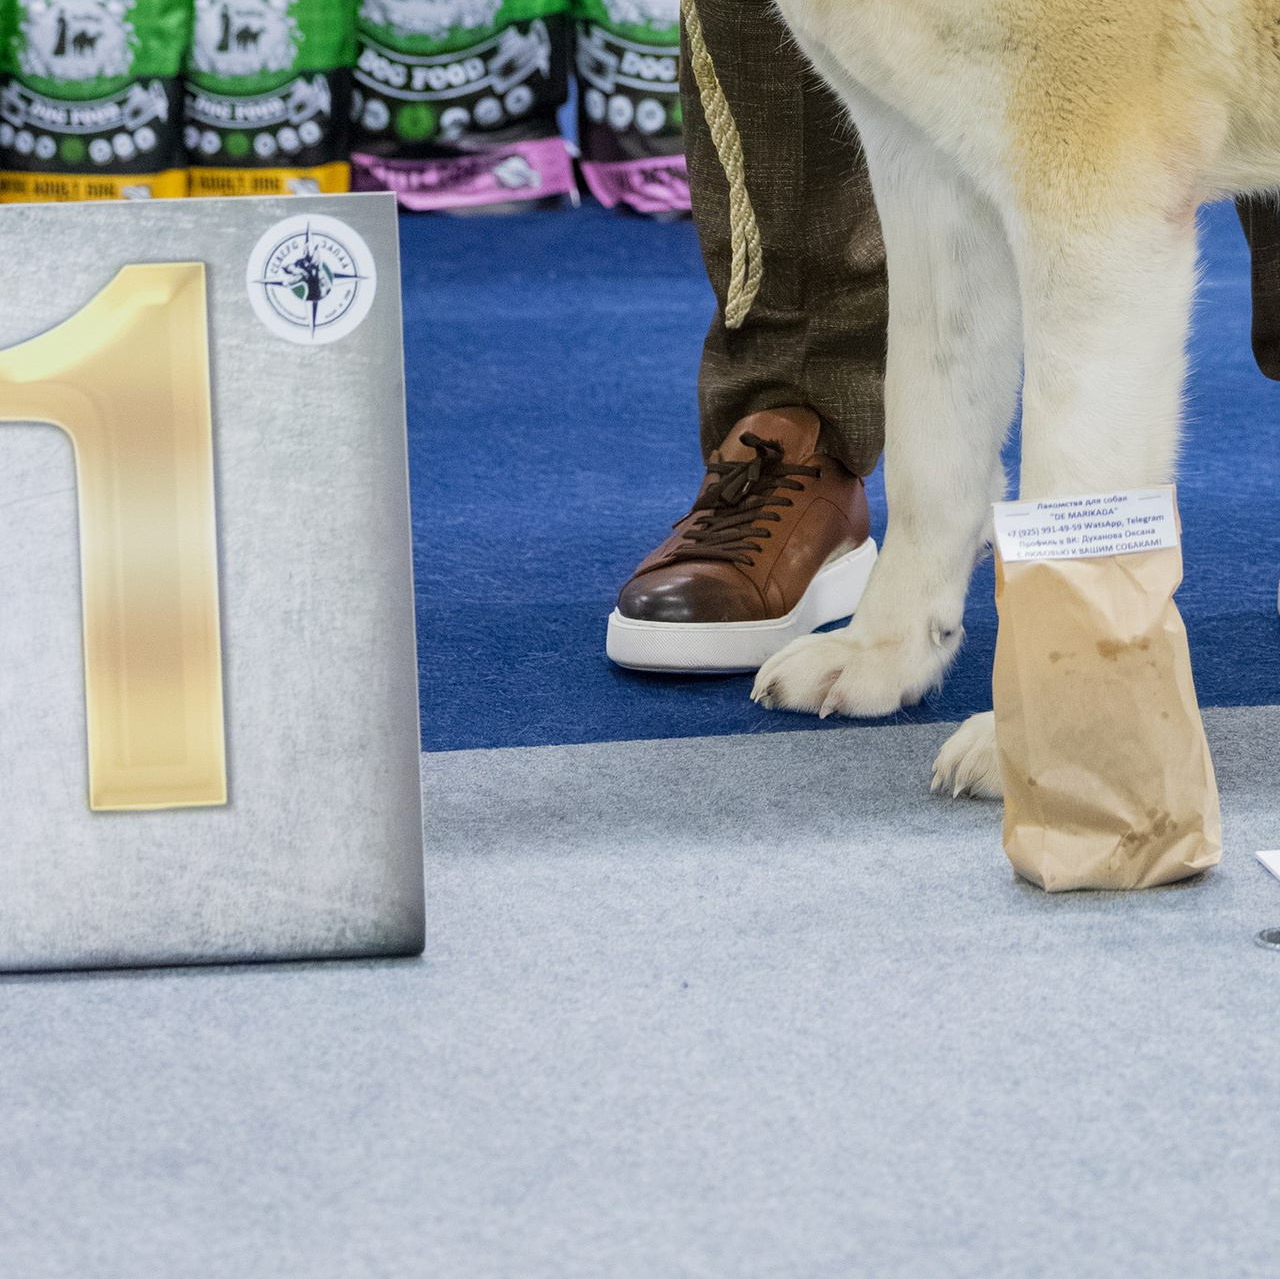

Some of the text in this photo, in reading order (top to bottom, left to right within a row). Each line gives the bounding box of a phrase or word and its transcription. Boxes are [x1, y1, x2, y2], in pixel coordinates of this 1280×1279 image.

[1036, 500, 1083, 510] Лакомства
[1085, 498, 1102, 506] для
[1126, 514, 1165, 526] Telegram
[0, 262, 228, 812] 1
